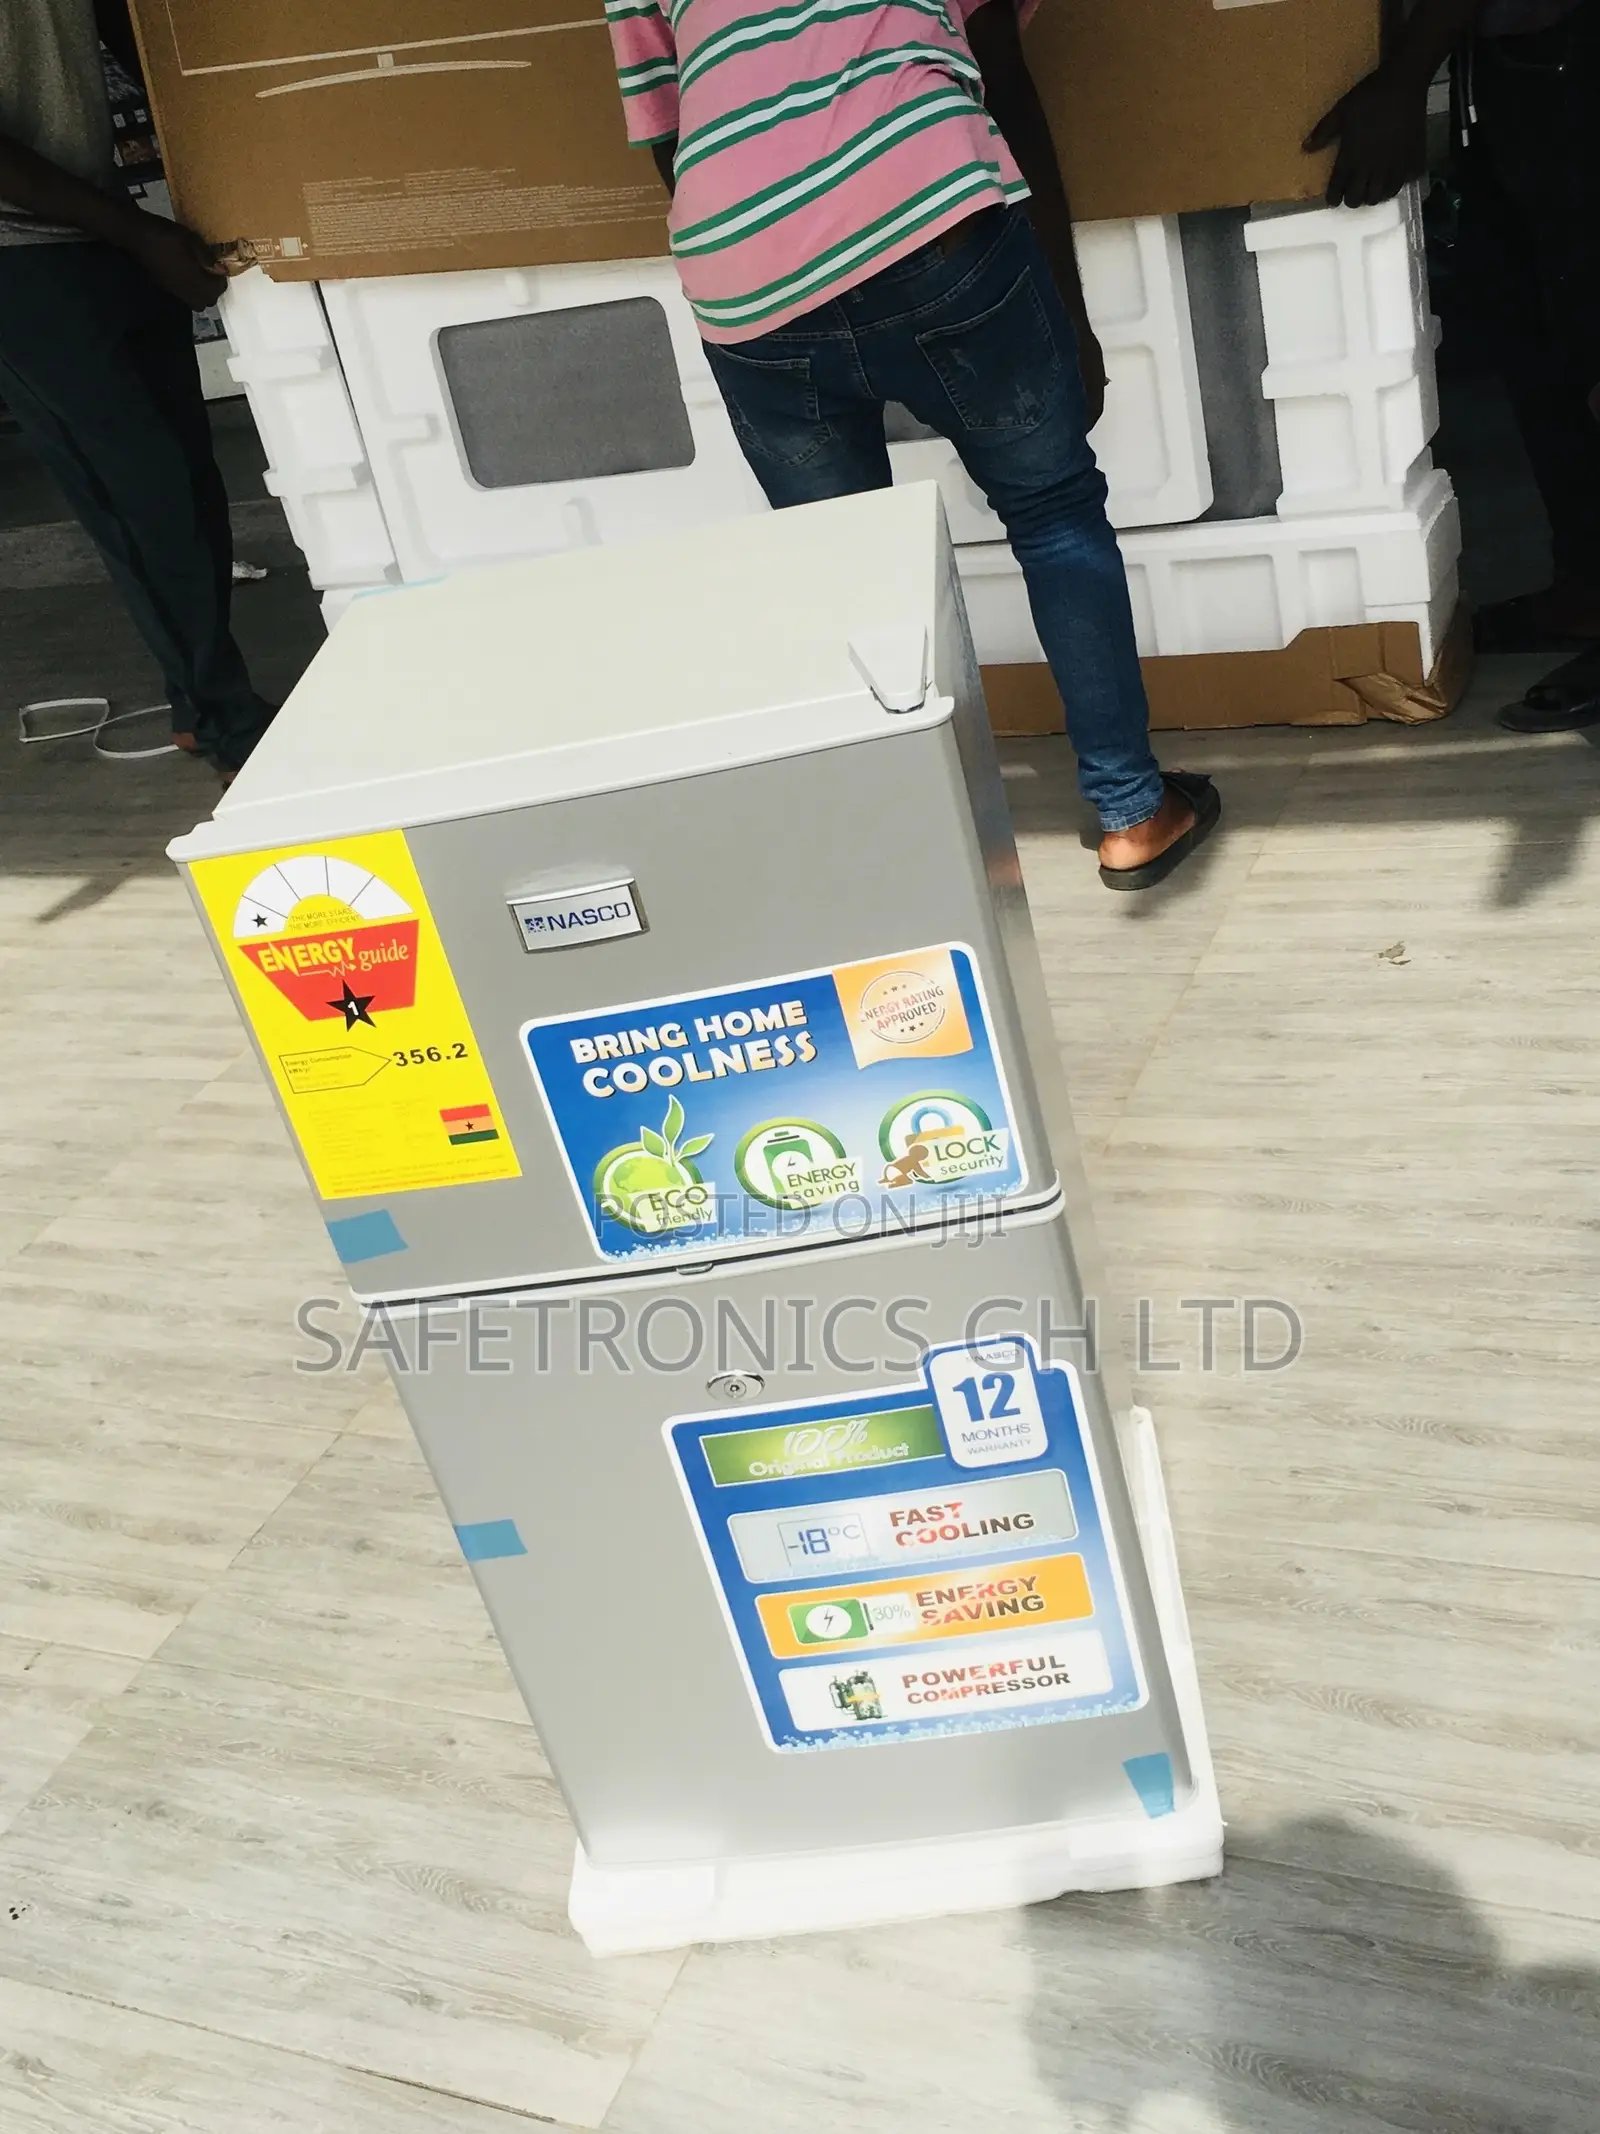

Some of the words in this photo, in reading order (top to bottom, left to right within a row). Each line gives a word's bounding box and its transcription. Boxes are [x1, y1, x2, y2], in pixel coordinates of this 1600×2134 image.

[547, 902, 631, 931] NASCO
[257, 937, 356, 978] ENERGY
[358, 938, 409, 972] guide
[347, 1000, 360, 1016] 1
[861, 1001, 900, 1022] NERGY
[902, 985, 944, 1008] RATING
[876, 1001, 937, 1030] APPROVED
[570, 1022, 689, 1064] BRING
[694, 1000, 808, 1043] HOME
[393, 1042, 468, 1067] 356.2
[582, 1030, 818, 1098] COOLNESS
[934, 1134, 1001, 1162] LOCK
[787, 1163, 856, 1188] ENERGY
[940, 1155, 1004, 1176] security
[648, 1186, 709, 1211] ECO
[793, 1179, 860, 1201] saving
[656, 1208, 713, 1227] friendly
[974, 1349, 1020, 1362] NASCO
[952, 1372, 1021, 1422] 12
[784, 1419, 869, 1458] 100%
[961, 1423, 1031, 1442] MONTHS
[967, 1439, 1032, 1455] WARRANTY
[749, 1453, 831, 1476] Original
[836, 1443, 909, 1465] Product
[889, 1502, 963, 1527] FAST
[895, 1513, 1035, 1547] COOLING
[915, 1575, 1037, 1607] ENERGY
[872, 1603, 912, 1622] 30%
[920, 1594, 1045, 1626] SAVING
[901, 1655, 1066, 1689] POWERFUL
[907, 1672, 1071, 1705] COMPRESSOR
